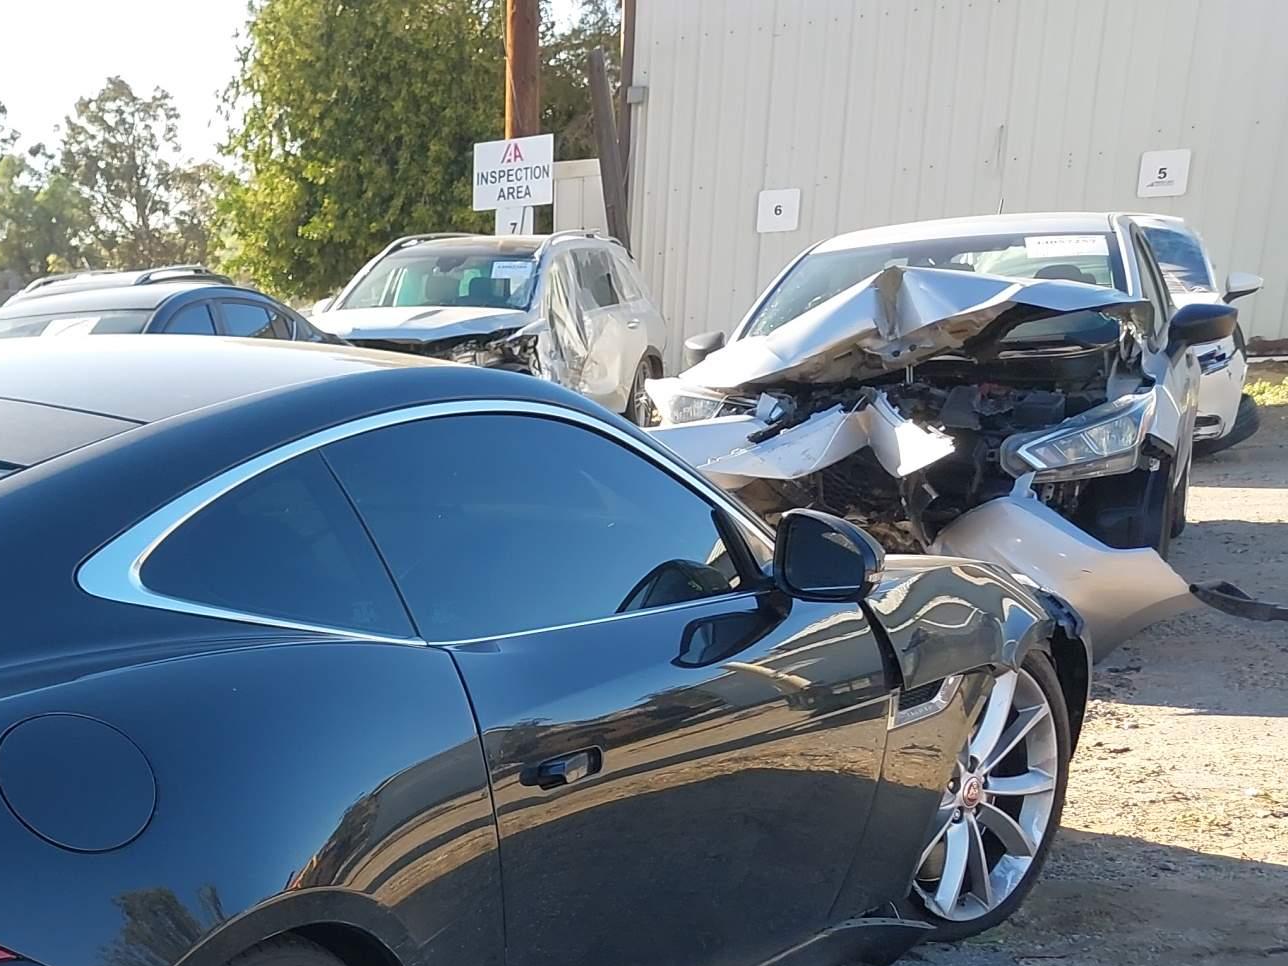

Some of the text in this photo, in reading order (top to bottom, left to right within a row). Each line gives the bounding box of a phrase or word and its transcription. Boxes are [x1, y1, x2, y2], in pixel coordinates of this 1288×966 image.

[476, 164, 550, 186] INSPECTION
[1157, 167, 1167, 180] 5
[497, 185, 532, 201] AREA
[774, 204, 783, 216] 6
[510, 222, 518, 235] 7
